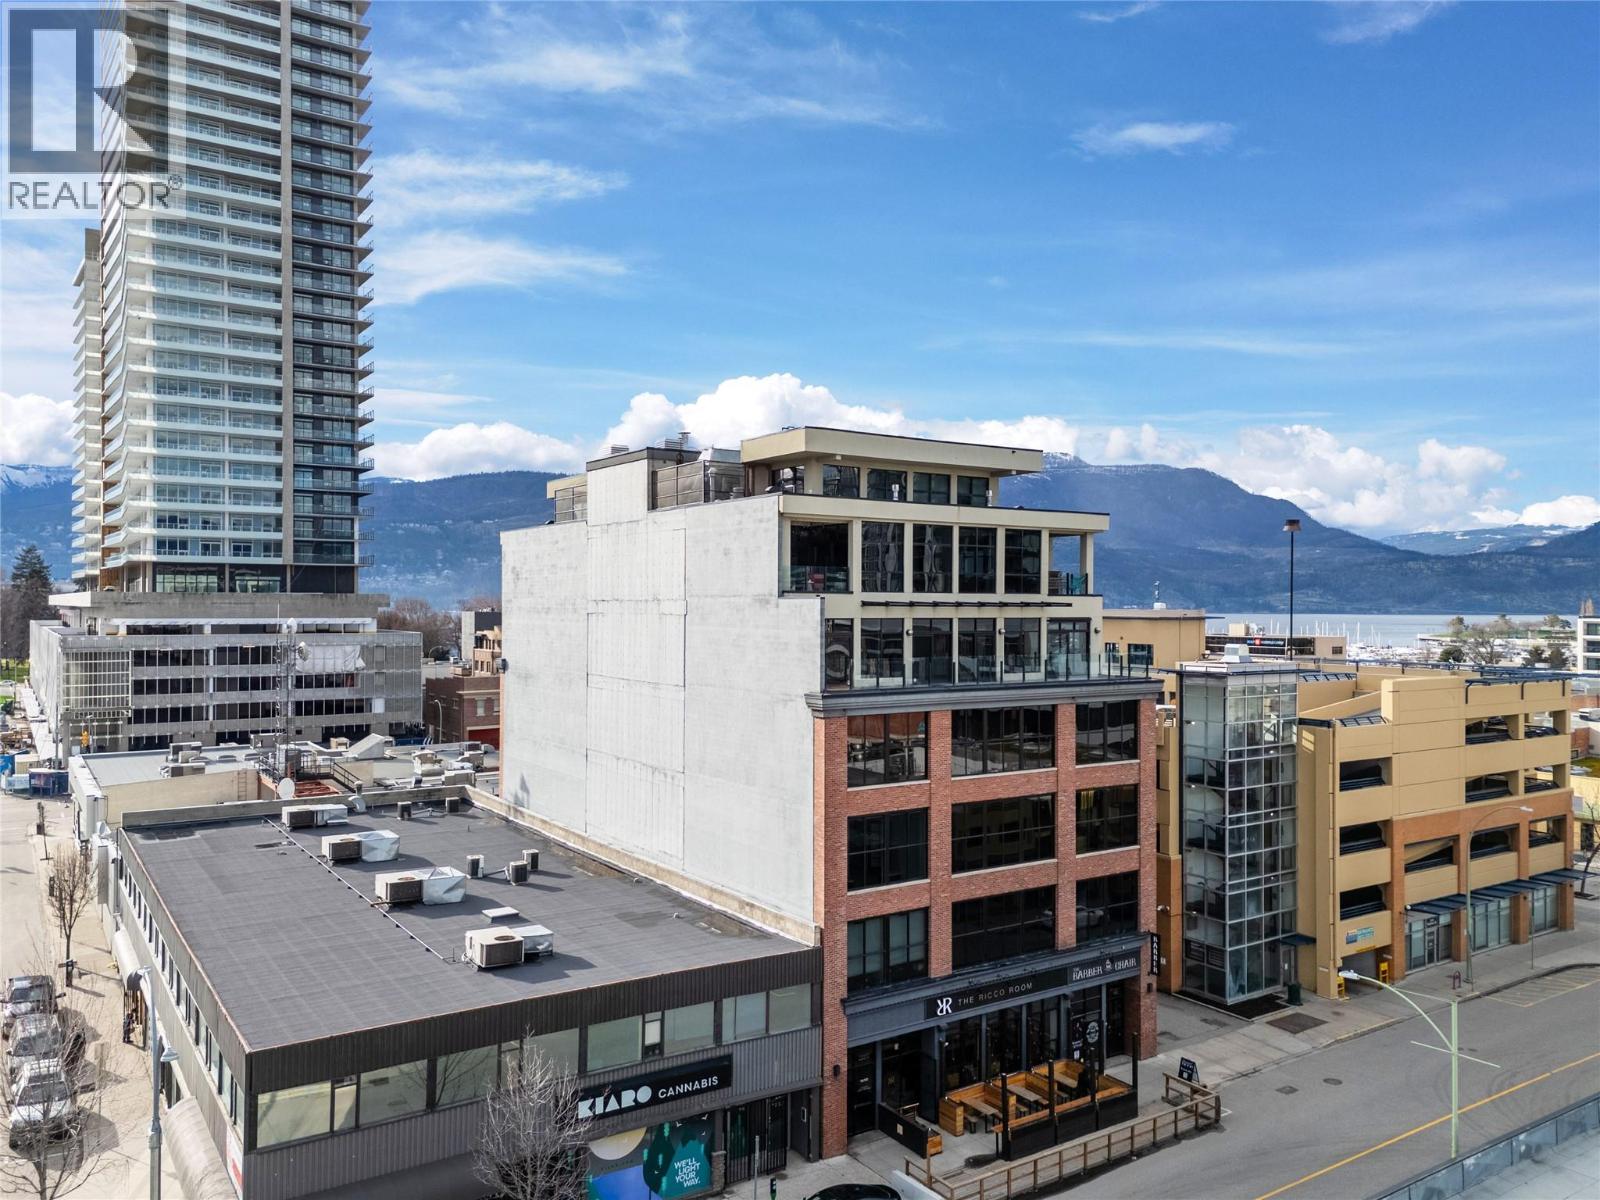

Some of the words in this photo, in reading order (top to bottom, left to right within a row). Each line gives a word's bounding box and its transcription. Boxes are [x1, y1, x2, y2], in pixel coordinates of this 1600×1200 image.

[1072, 965, 1103, 981] BARBER
[1114, 957, 1137, 971] CHAIR
[958, 996, 974, 1006] THE
[978, 988, 1006, 1001] RICCO
[1008, 982, 1033, 994] ROOM
[577, 1085, 652, 1119] KIARO
[658, 1076, 719, 1099] CANNABIS
[674, 1157, 697, 1169] WE'LL
[678, 1162, 701, 1176] LIGHT
[675, 1171, 696, 1184] YOUR
